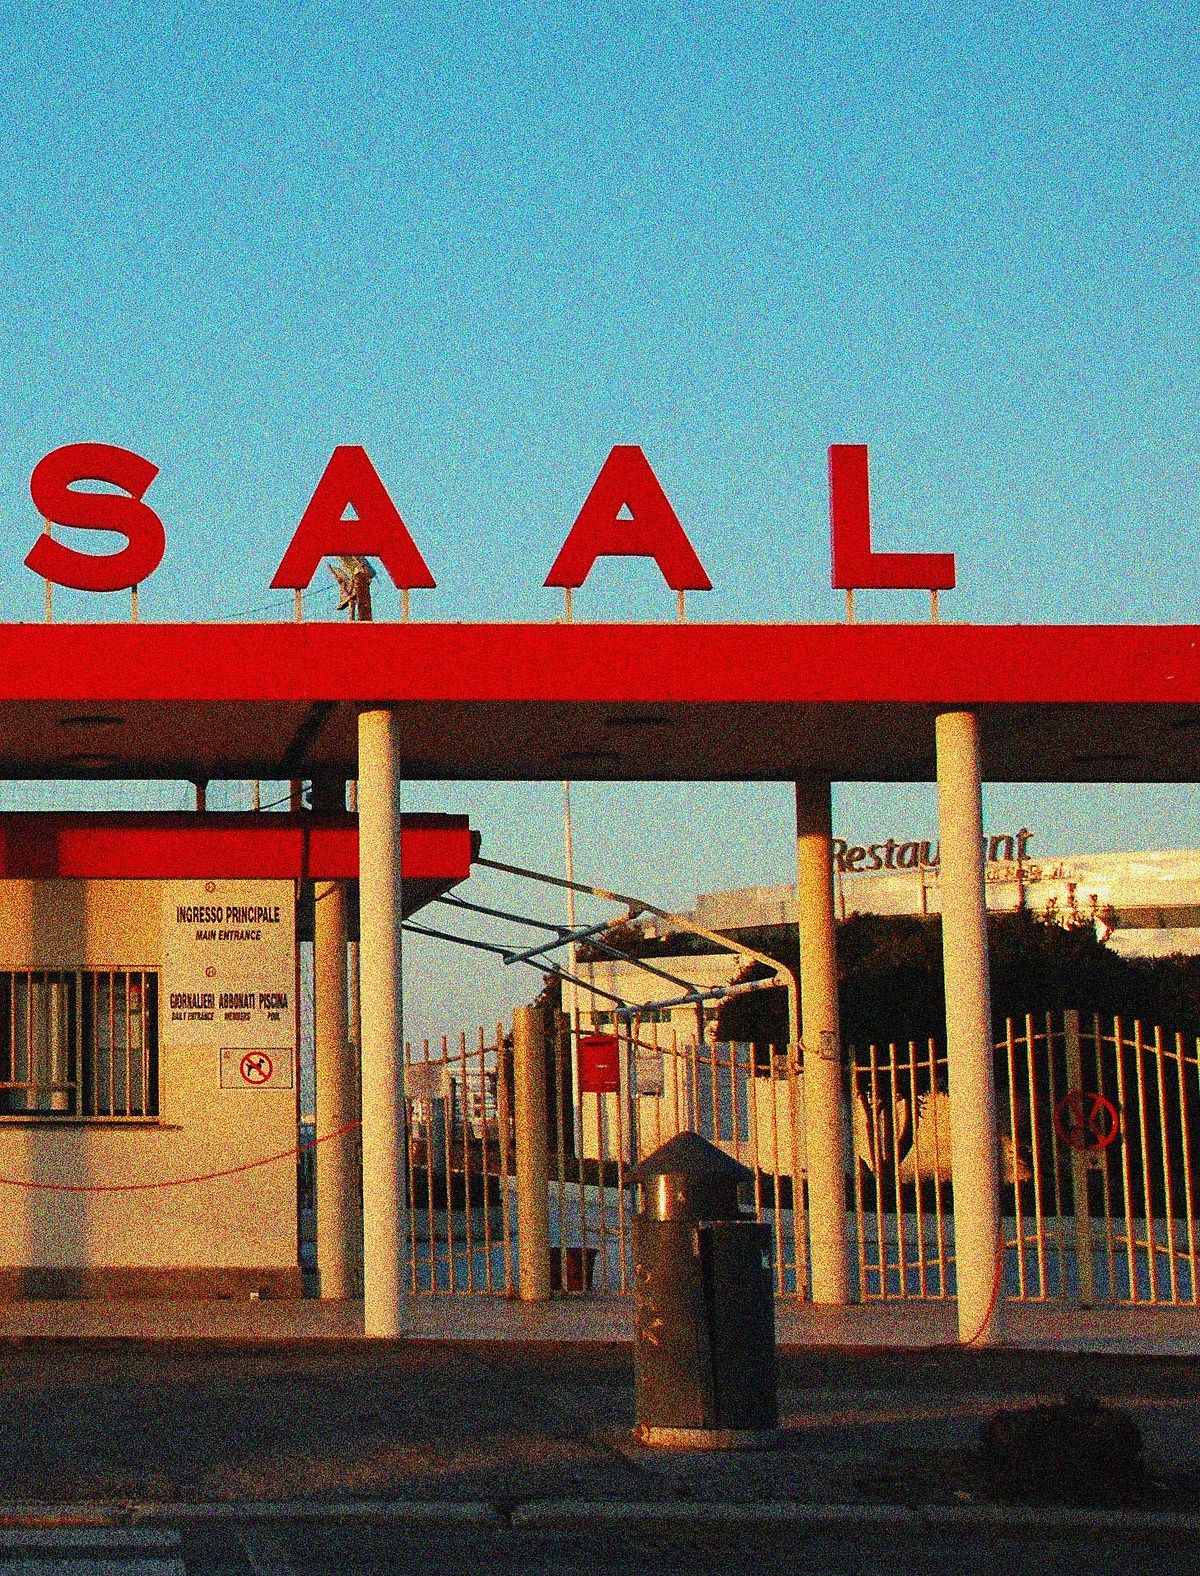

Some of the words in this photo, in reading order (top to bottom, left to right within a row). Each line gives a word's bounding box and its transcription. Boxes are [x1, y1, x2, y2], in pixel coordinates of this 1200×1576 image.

[832, 828, 1034, 872] Restaunt
[176, 906, 222, 923] INGRESSO
[225, 906, 280, 923] PRINCIPALE
[195, 930, 216, 940] MAIN
[218, 930, 261, 940] ENTRANCE
[219, 993, 255, 1009] ABBONATI
[259, 993, 288, 1009] PISCINA
